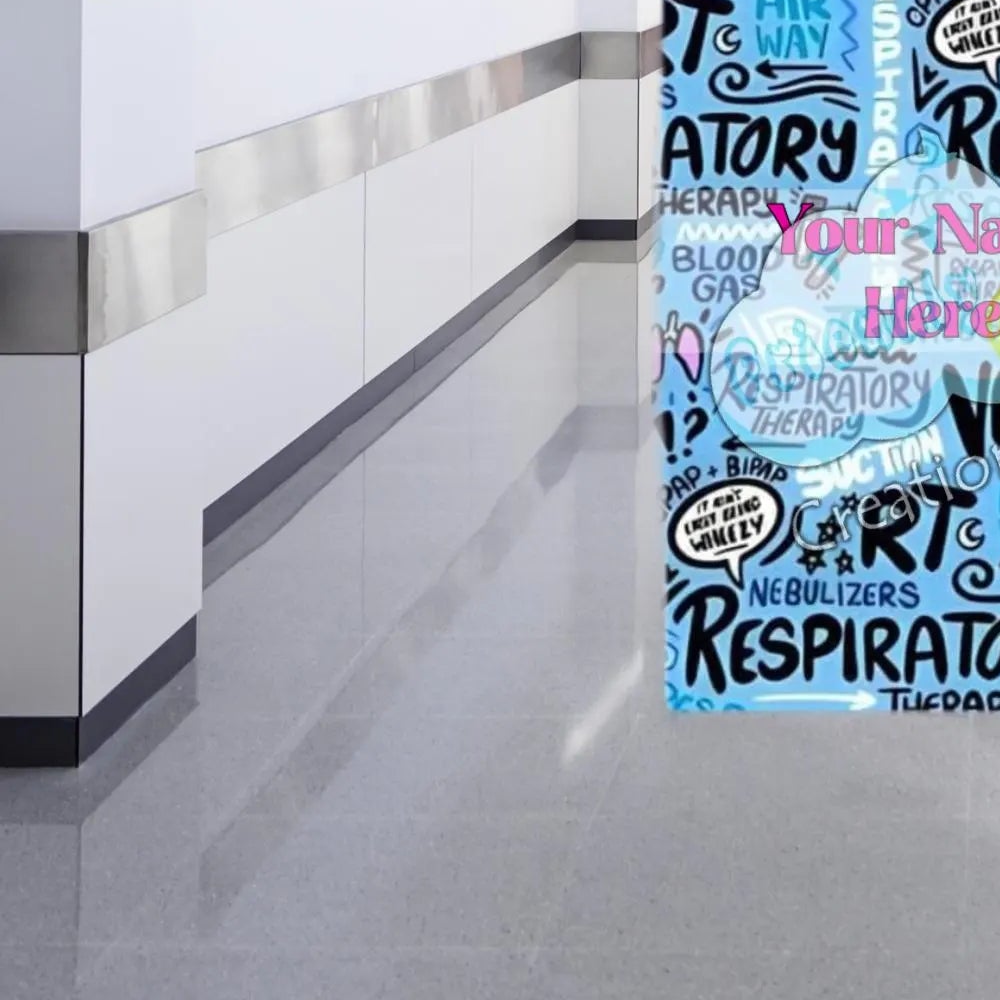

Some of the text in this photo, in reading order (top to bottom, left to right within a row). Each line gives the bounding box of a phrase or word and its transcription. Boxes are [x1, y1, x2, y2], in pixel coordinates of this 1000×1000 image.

[756, 23, 830, 59] WAY
[661, 112, 857, 183] ATORY
[766, 202, 910, 256] Your
[692, 273, 766, 303] GAS
[750, 405, 865, 440] THERAPY
[726, 454, 789, 482] BIPAP
[796, 423, 946, 499] SUCTION
[860, 483, 978, 575] RT
[749, 577, 921, 609] NEBULIZERS
